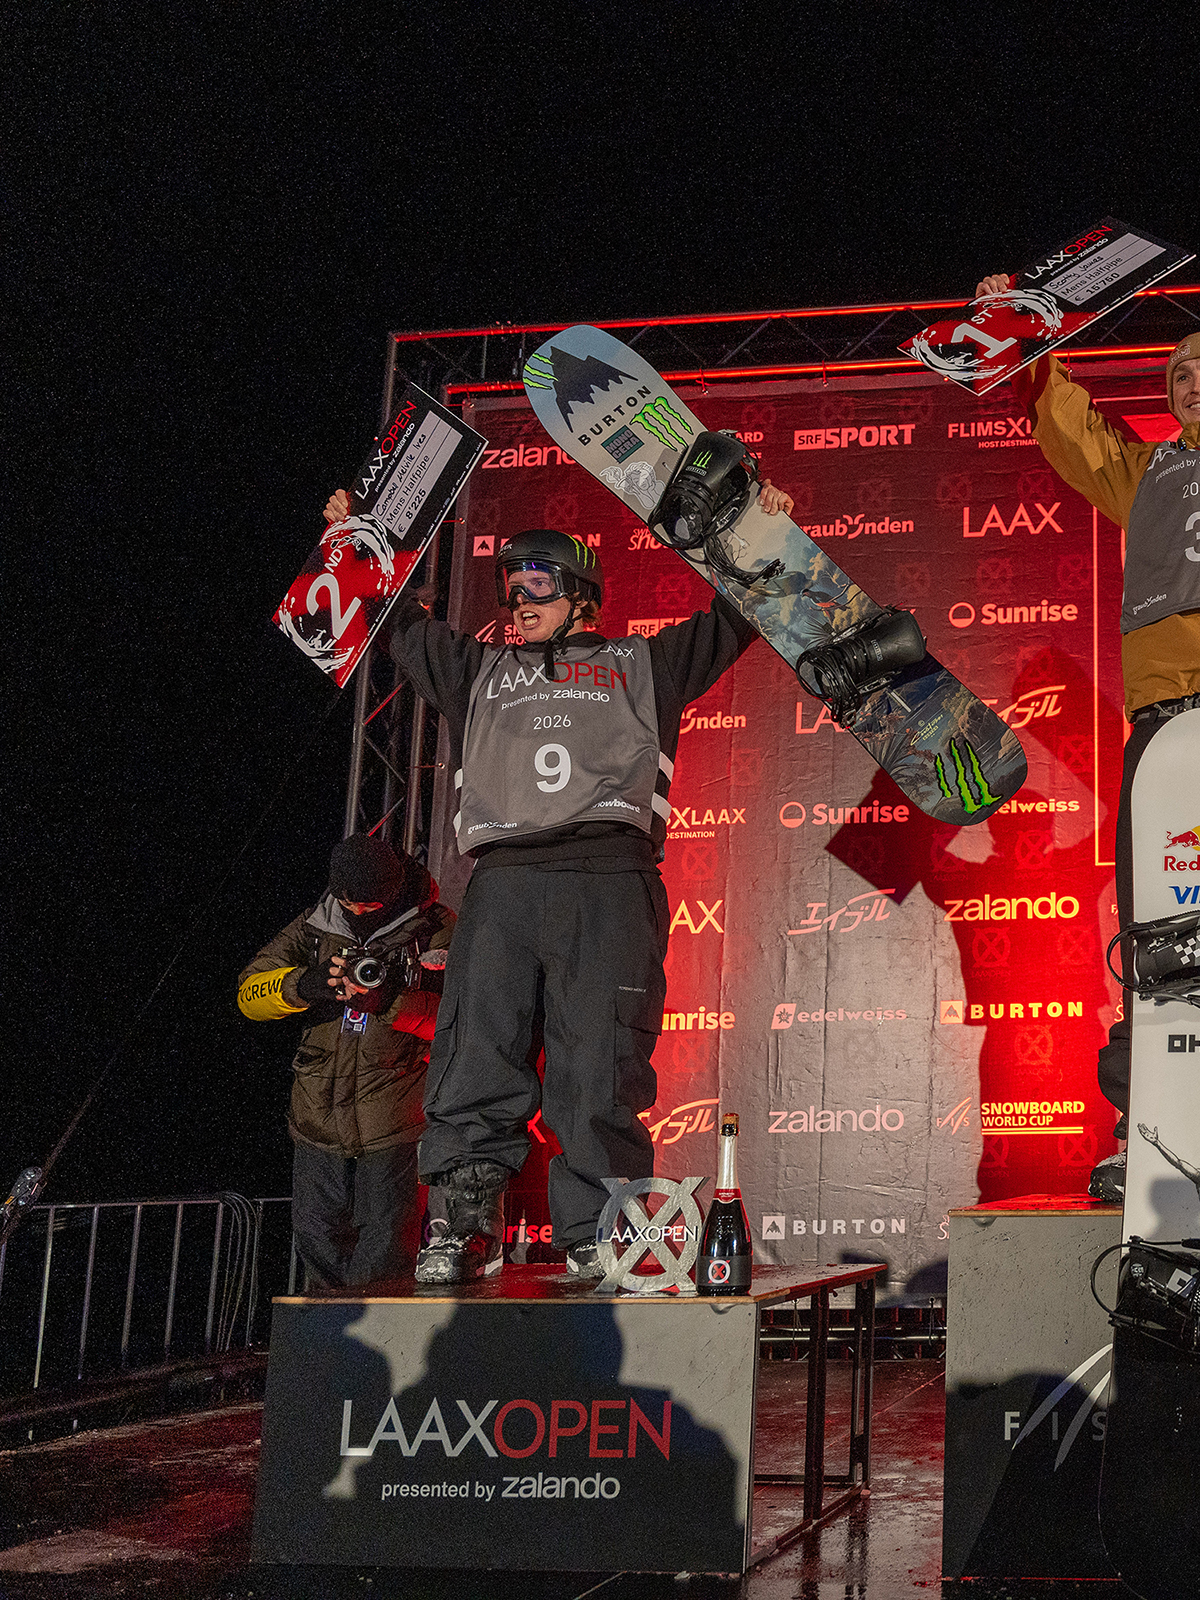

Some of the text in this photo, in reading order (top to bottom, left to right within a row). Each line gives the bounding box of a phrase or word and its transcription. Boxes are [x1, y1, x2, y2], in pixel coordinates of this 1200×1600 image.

[1025, 225, 1112, 279] LAAXOPEN
[1078, 238, 1109, 258] zalando
[1060, 279, 1087, 296] Mens
[1087, 257, 1123, 281] Halfpipe
[971, 309, 993, 325] ST
[578, 385, 652, 446] BURTON
[355, 400, 417, 499] LAAXOPEN
[605, 429, 634, 454] MONO
[797, 424, 916, 449] SRF SPORT
[978, 439, 1039, 449] HOST DESTINAT
[374, 465, 391, 492] presented
[393, 423, 415, 458] zalando
[482, 444, 577, 469] zalan
[1155, 461, 1185, 483] presented
[1186, 458, 1197, 470] by
[386, 497, 406, 525] Mens
[404, 455, 430, 497] Halfpipe
[405, 488, 427, 520] 8'225
[963, 502, 1064, 538] LAAX
[324, 547, 344, 573] ND
[306, 573, 362, 640] 2
[980, 599, 1078, 626] Sunrise
[487, 661, 627, 700] LAAXOPEN
[501, 688, 610, 710] presented by zalando
[533, 714, 572, 730] 2026
[534, 743, 572, 793] 9
[811, 800, 910, 825] Sunrise
[944, 892, 1079, 922] zalando
[797, 1006, 907, 1023] edelweiss
[970, 1002, 1083, 1019] BURTON
[768, 1105, 904, 1133] zalando
[981, 1101, 1085, 1115] SNOWBOARD
[982, 1115, 1054, 1127] WORLD CUP
[600, 1225, 698, 1243] LAAXOPEN
[793, 1218, 906, 1235] BURTON
[340, 1397, 672, 1461] LAAXOPEN
[381, 1472, 620, 1501] presented by zalando
